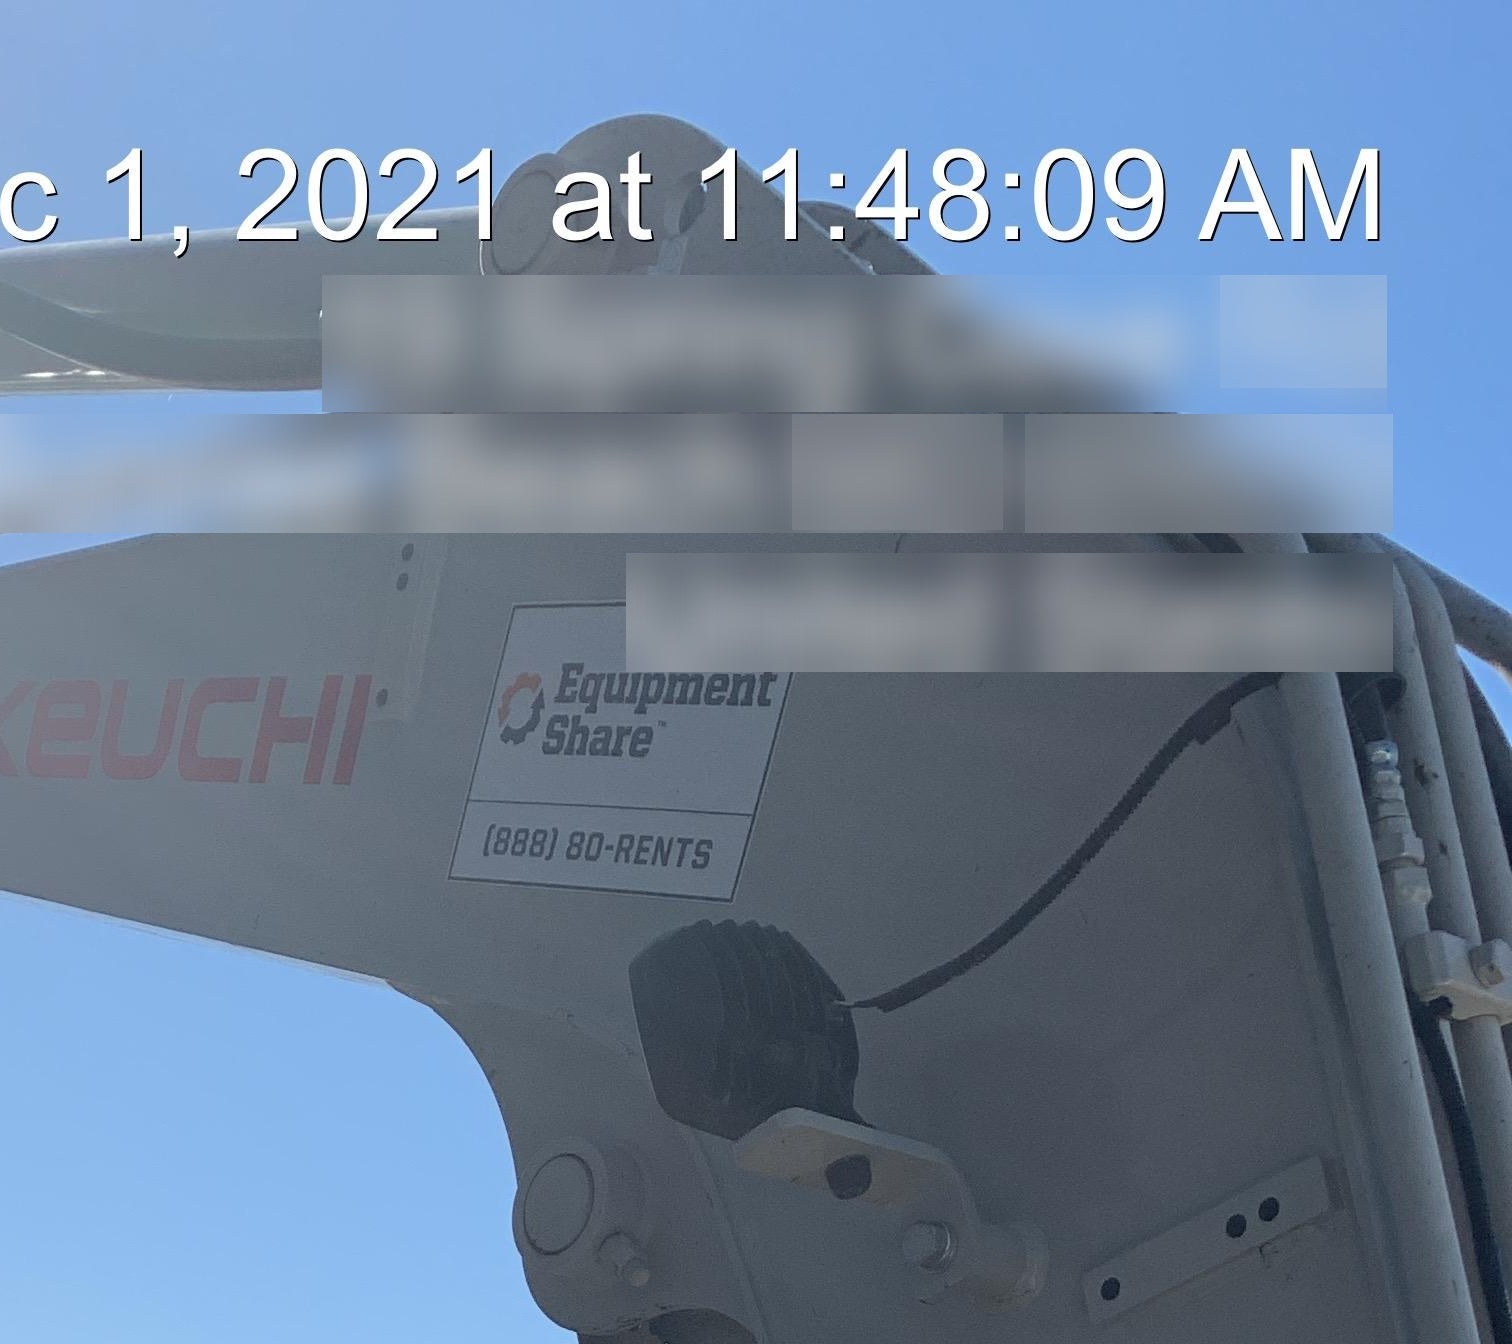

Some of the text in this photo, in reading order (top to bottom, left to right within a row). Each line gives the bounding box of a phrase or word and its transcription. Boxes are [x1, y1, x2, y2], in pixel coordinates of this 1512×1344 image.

[554, 662, 778, 715] Equipment
[541, 714, 654, 758] Share
[483, 823, 714, 870] (888) 80-RENTS
